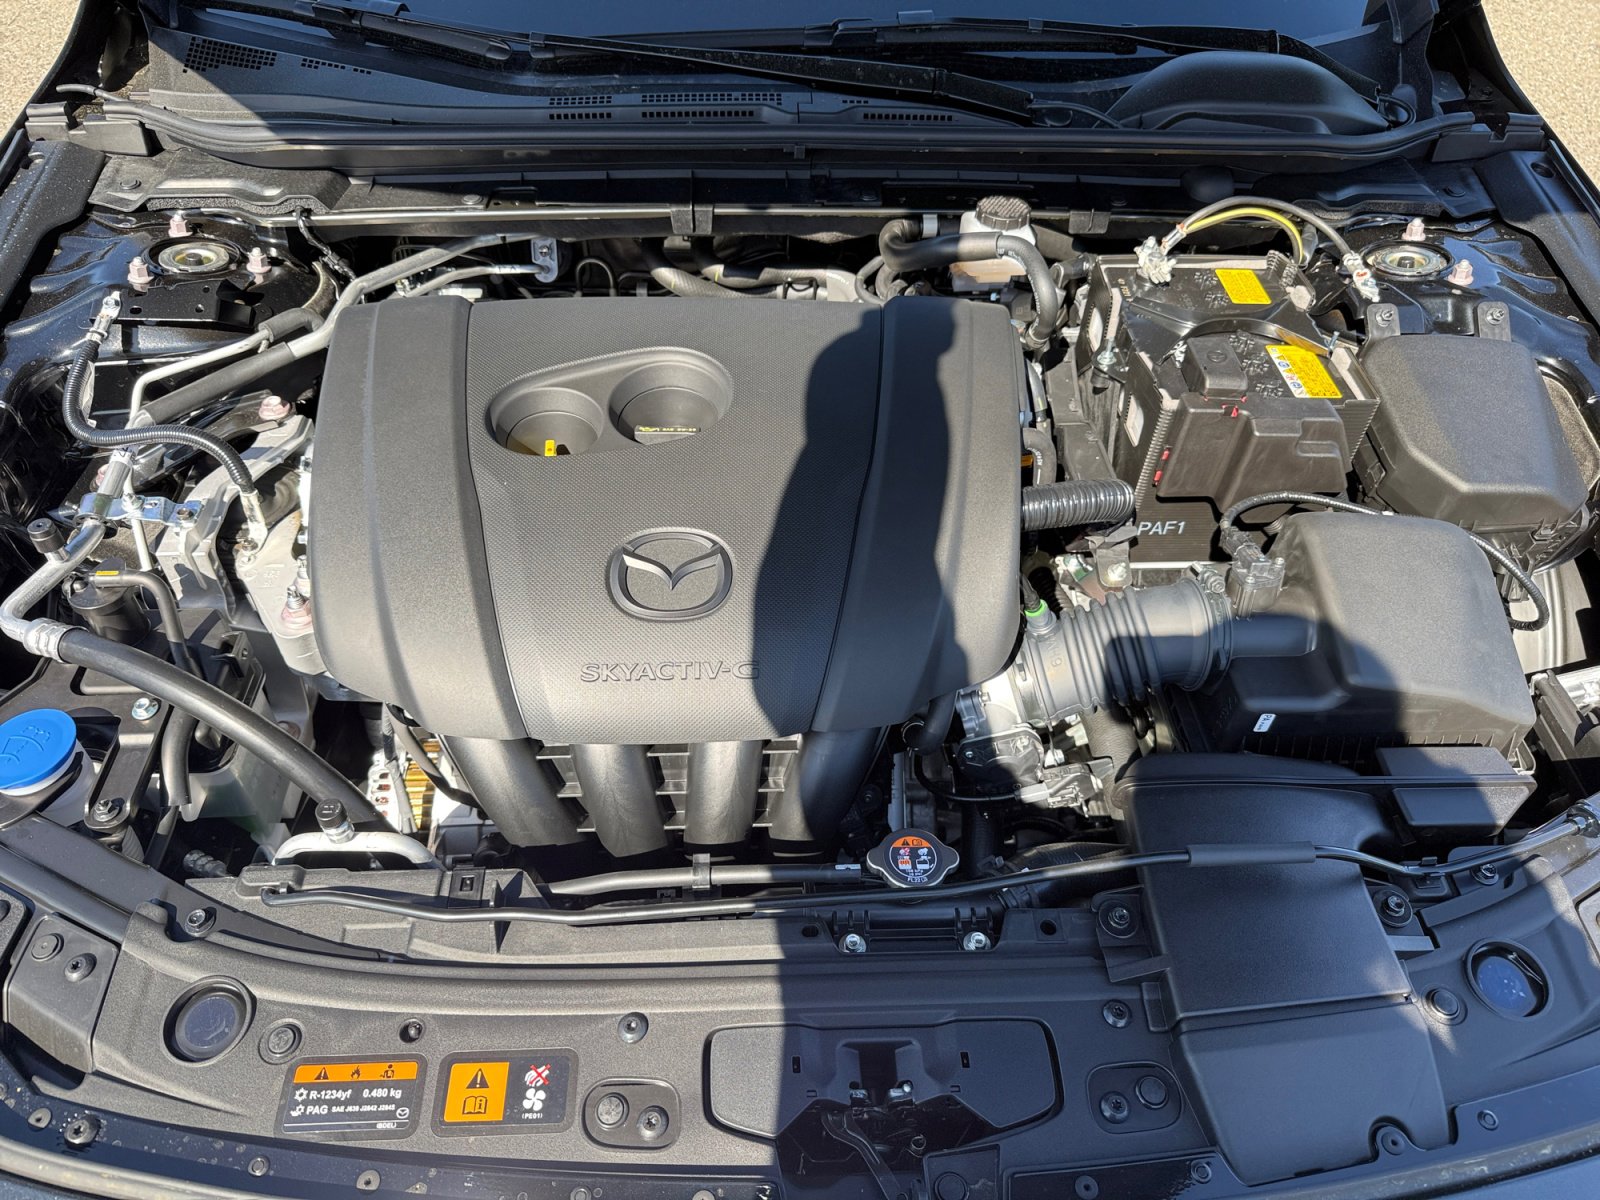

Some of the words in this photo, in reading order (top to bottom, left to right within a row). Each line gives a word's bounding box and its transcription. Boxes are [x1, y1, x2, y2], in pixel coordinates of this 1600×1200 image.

[1137, 521, 1186, 536] PAF1
[580, 660, 760, 683] SKYACTIV-G
[309, 1089, 352, 1101] R-1234yf
[362, 1088, 388, 1098] 0.480
[389, 1087, 402, 1098] kg
[306, 1105, 328, 1115] PAG
